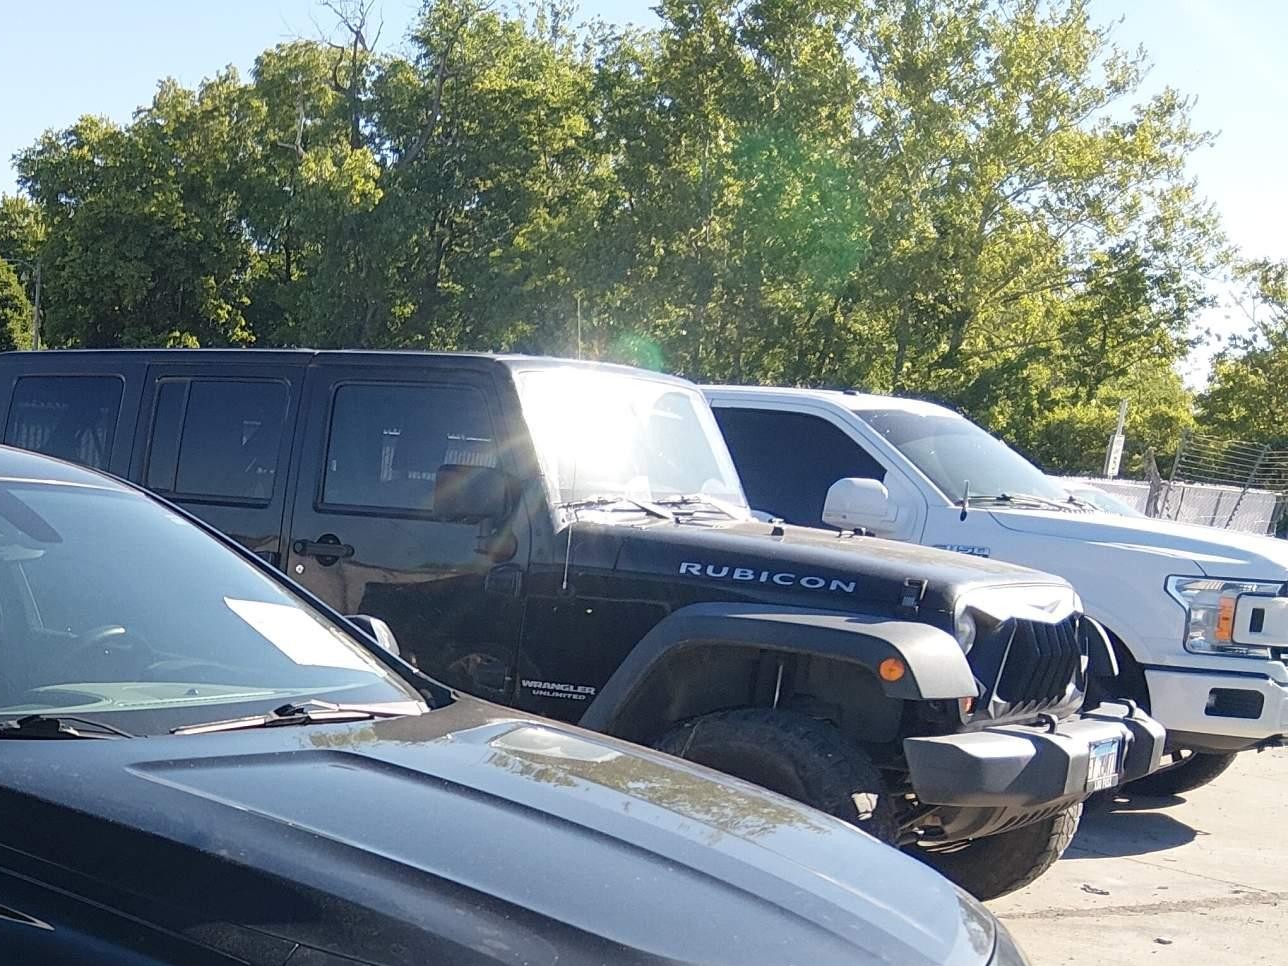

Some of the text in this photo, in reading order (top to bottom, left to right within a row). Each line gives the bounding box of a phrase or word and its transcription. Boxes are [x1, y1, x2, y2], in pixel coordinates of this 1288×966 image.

[679, 562, 856, 593] RUBICON
[521, 679, 596, 695] WRANGLER
[532, 689, 586, 700] UNLIMITED
